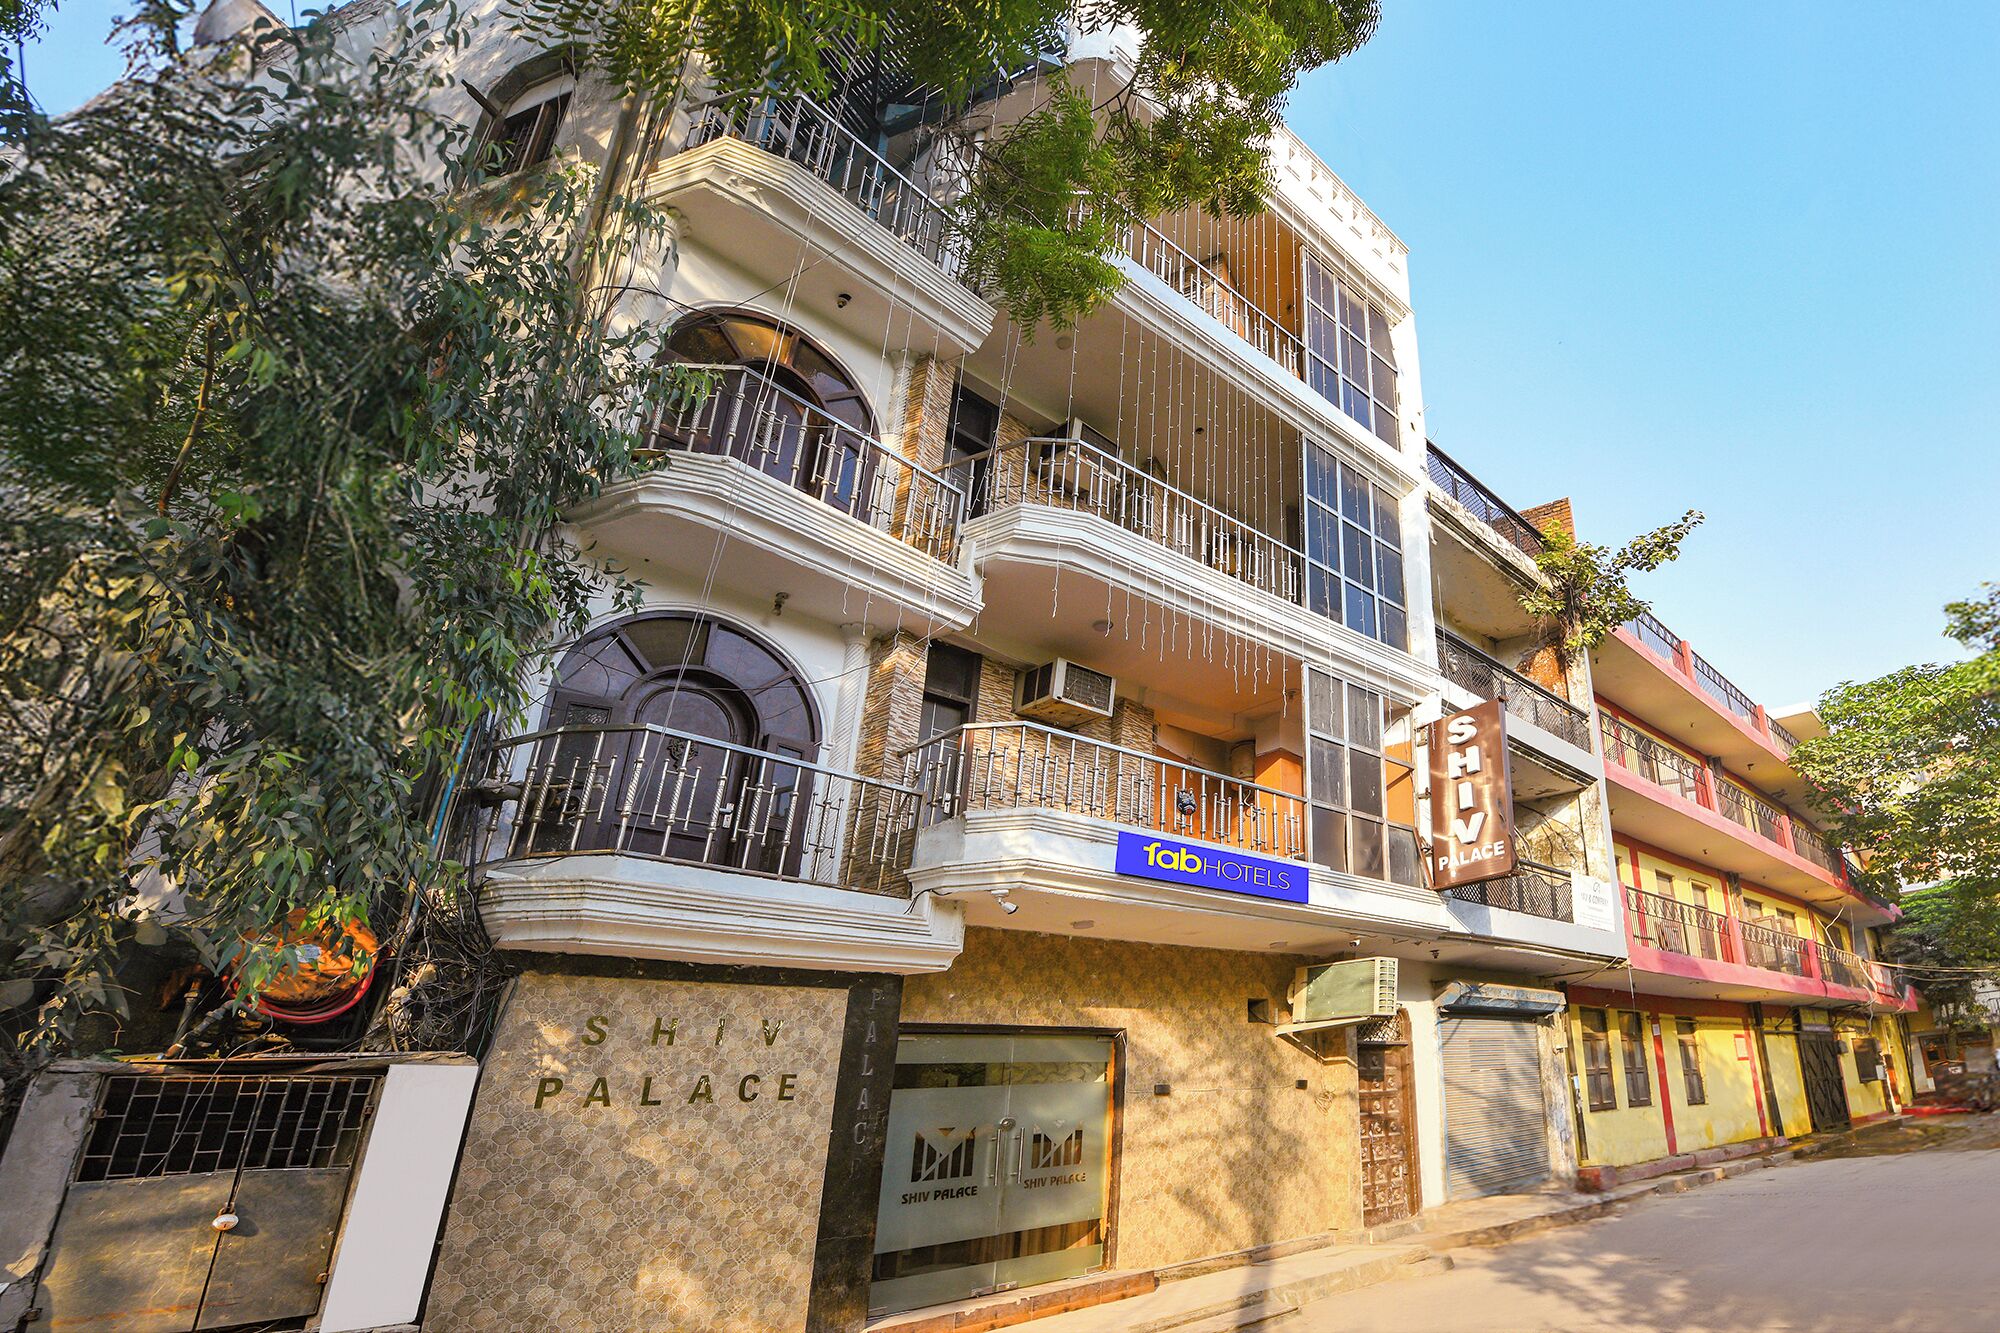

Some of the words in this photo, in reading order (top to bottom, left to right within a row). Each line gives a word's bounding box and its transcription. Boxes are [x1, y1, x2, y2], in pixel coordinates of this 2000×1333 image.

[1447, 715, 1487, 845] SHIV
[1438, 840, 1506, 872] PALACE
[581, 1015, 785, 1047] SHIV
[533, 1074, 798, 1110] PALACE
[901, 1191, 930, 1205] SHIV
[933, 1185, 978, 1201] PALACE
[1023, 1177, 1047, 1190] SHIV
[1050, 1172, 1087, 1187] PALACE
